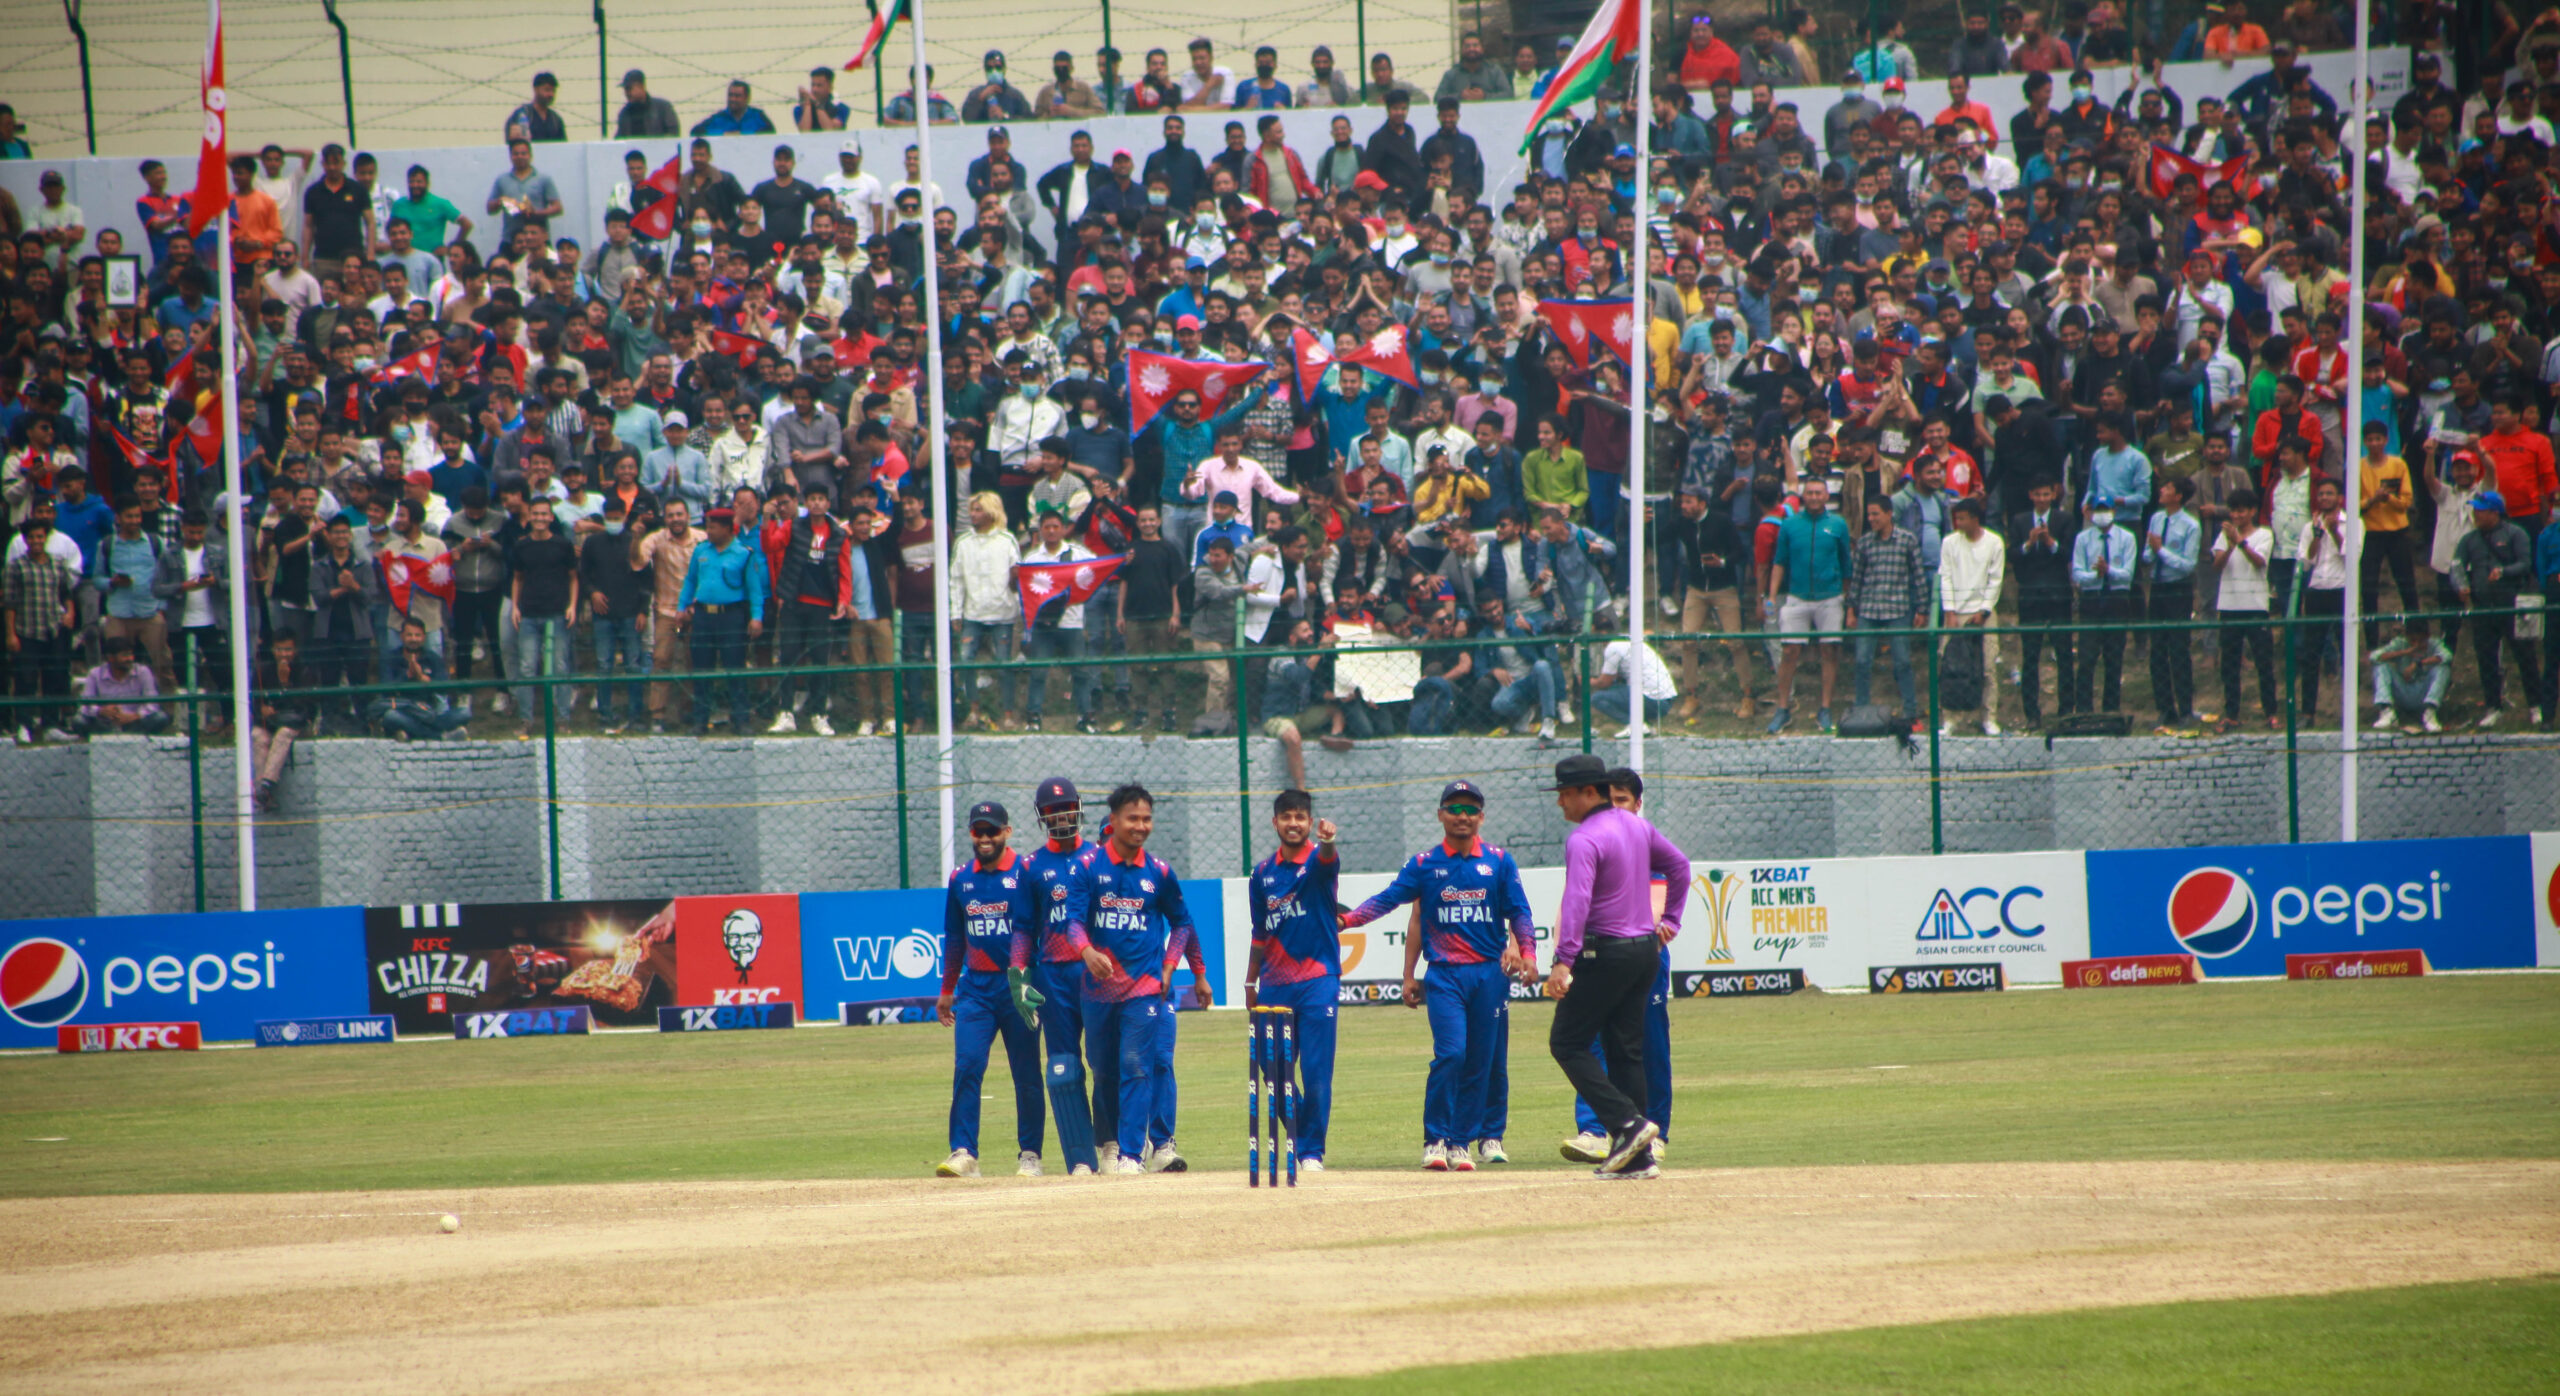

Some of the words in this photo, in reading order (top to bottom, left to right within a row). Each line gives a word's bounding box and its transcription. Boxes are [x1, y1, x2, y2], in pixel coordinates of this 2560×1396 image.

[1750, 867, 1811, 883] 1XBAT
[1751, 888, 1774, 906] ACC
[1779, 886, 1816, 905] MEN'S
[2271, 871, 2441, 938] pepsi
[1095, 911, 1147, 931] NEPAL
[1437, 906, 1493, 923] NEPAL
[1752, 906, 1829, 934] PREMIER
[1915, 886, 2045, 940] ACC
[412, 937, 452, 952] KFC
[1754, 936, 1803, 962] cup
[1916, 945, 1948, 955] ASIAN
[1951, 944, 1996, 955] CRICKET
[1999, 943, 2047, 953] COUNCIL
[103, 941, 276, 1007] pepsi
[376, 953, 489, 994] CHIZZA
[1711, 973, 1791, 993] SKYEXCH
[1904, 967, 1996, 989] SKYEXCH
[713, 987, 780, 1006] KFC
[1338, 984, 1404, 1001] SKYEXC
[466, 1009, 576, 1038] 1XBAT
[680, 1005, 775, 1031] 1XBAT
[111, 1025, 181, 1050] KFC
[262, 1020, 386, 1042] WORLDLINK
